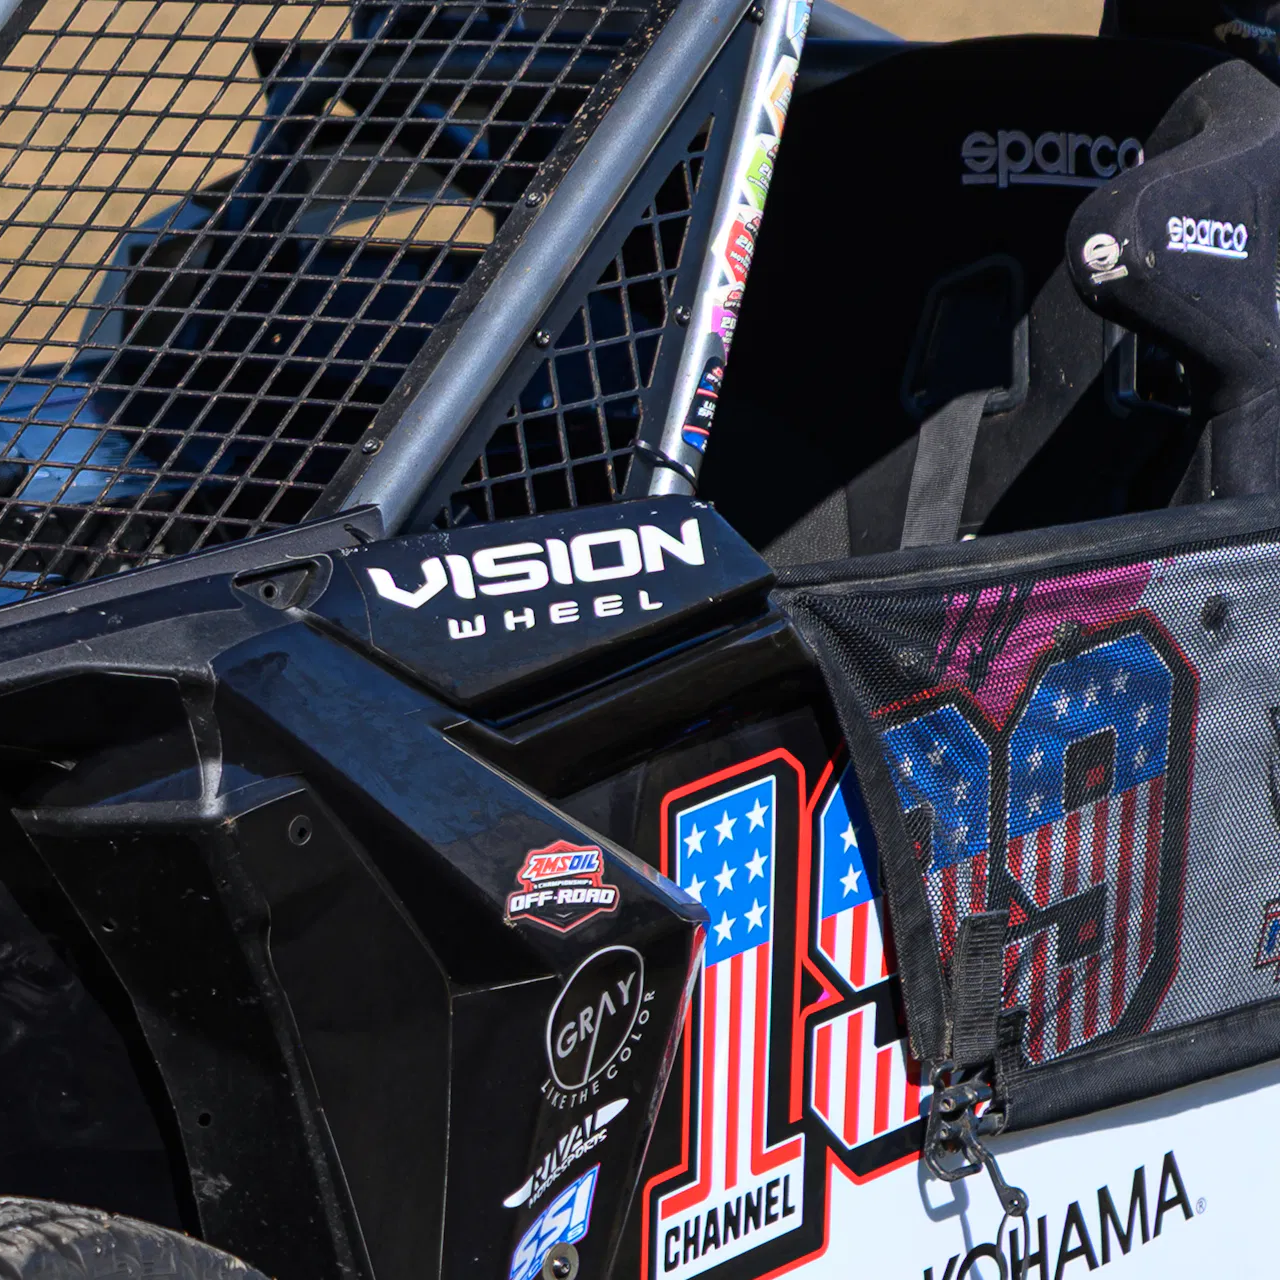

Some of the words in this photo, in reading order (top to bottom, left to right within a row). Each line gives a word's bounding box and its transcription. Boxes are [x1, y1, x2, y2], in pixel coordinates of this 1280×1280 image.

[961, 129, 1144, 188] sparco
[1167, 214, 1249, 260] sparco
[367, 517, 705, 609] VISION
[448, 590, 663, 640] WHEEL
[510, 888, 616, 912] OFF-ROAD
[526, 852, 598, 880] AMSOIL
[541, 1077, 568, 1110] LIKE
[570, 1082, 600, 1109] THE
[606, 988, 657, 1081] COLOR
[555, 970, 638, 1059] GRAY
[528, 1128, 608, 1209] MOTORSPORTS
[664, 1173, 796, 1273] CHANNEL
